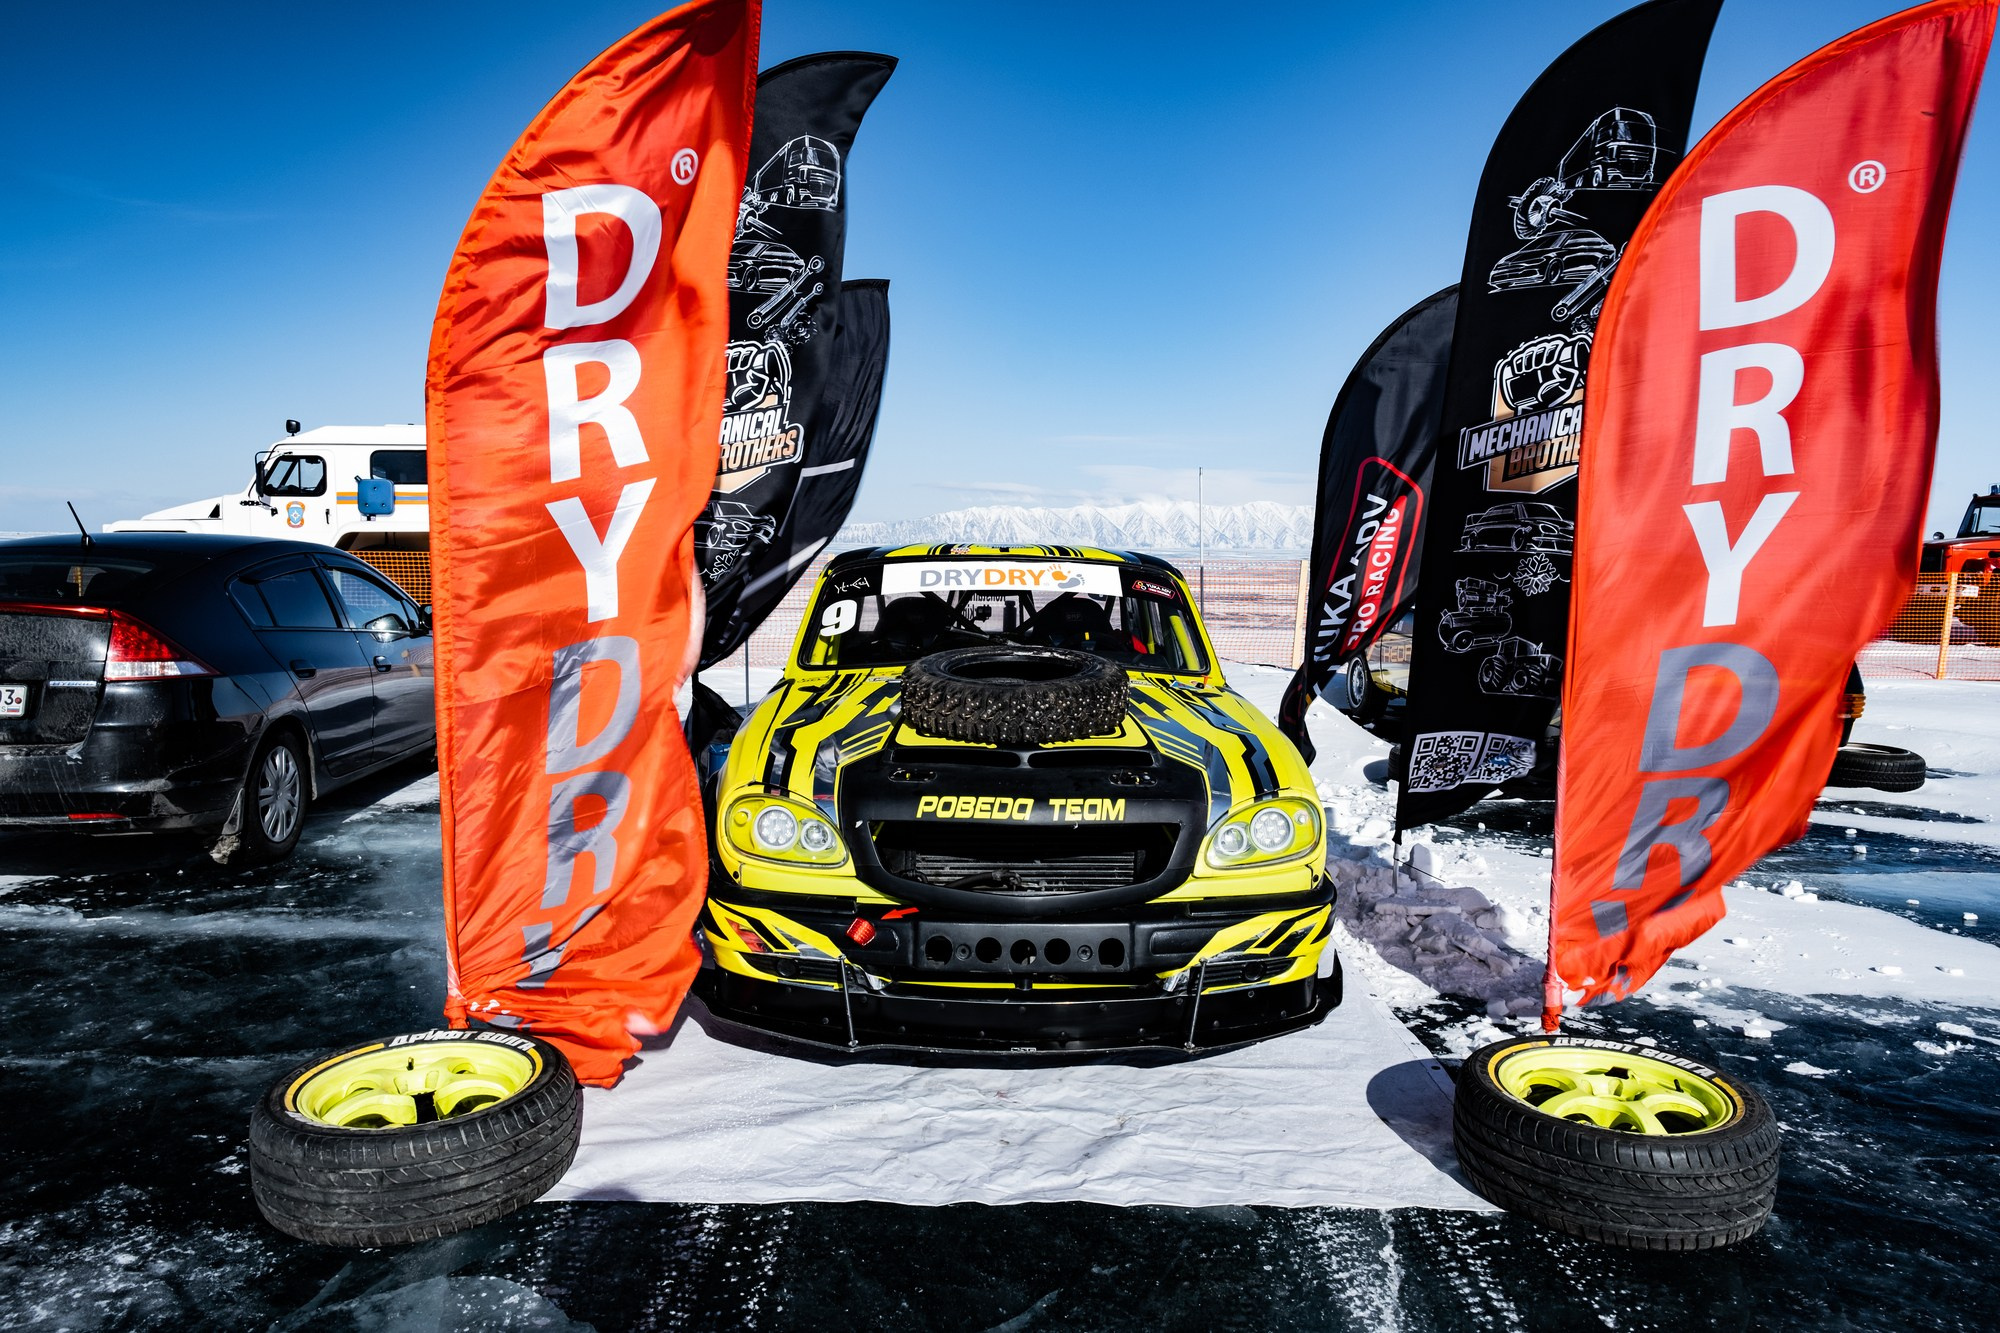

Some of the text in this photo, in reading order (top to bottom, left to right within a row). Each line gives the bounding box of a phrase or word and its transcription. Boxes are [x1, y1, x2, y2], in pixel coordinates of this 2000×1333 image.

[1364, 507, 1401, 600] RACING
[820, 599, 857, 637] 9
[0, 689, 16, 706] 3
